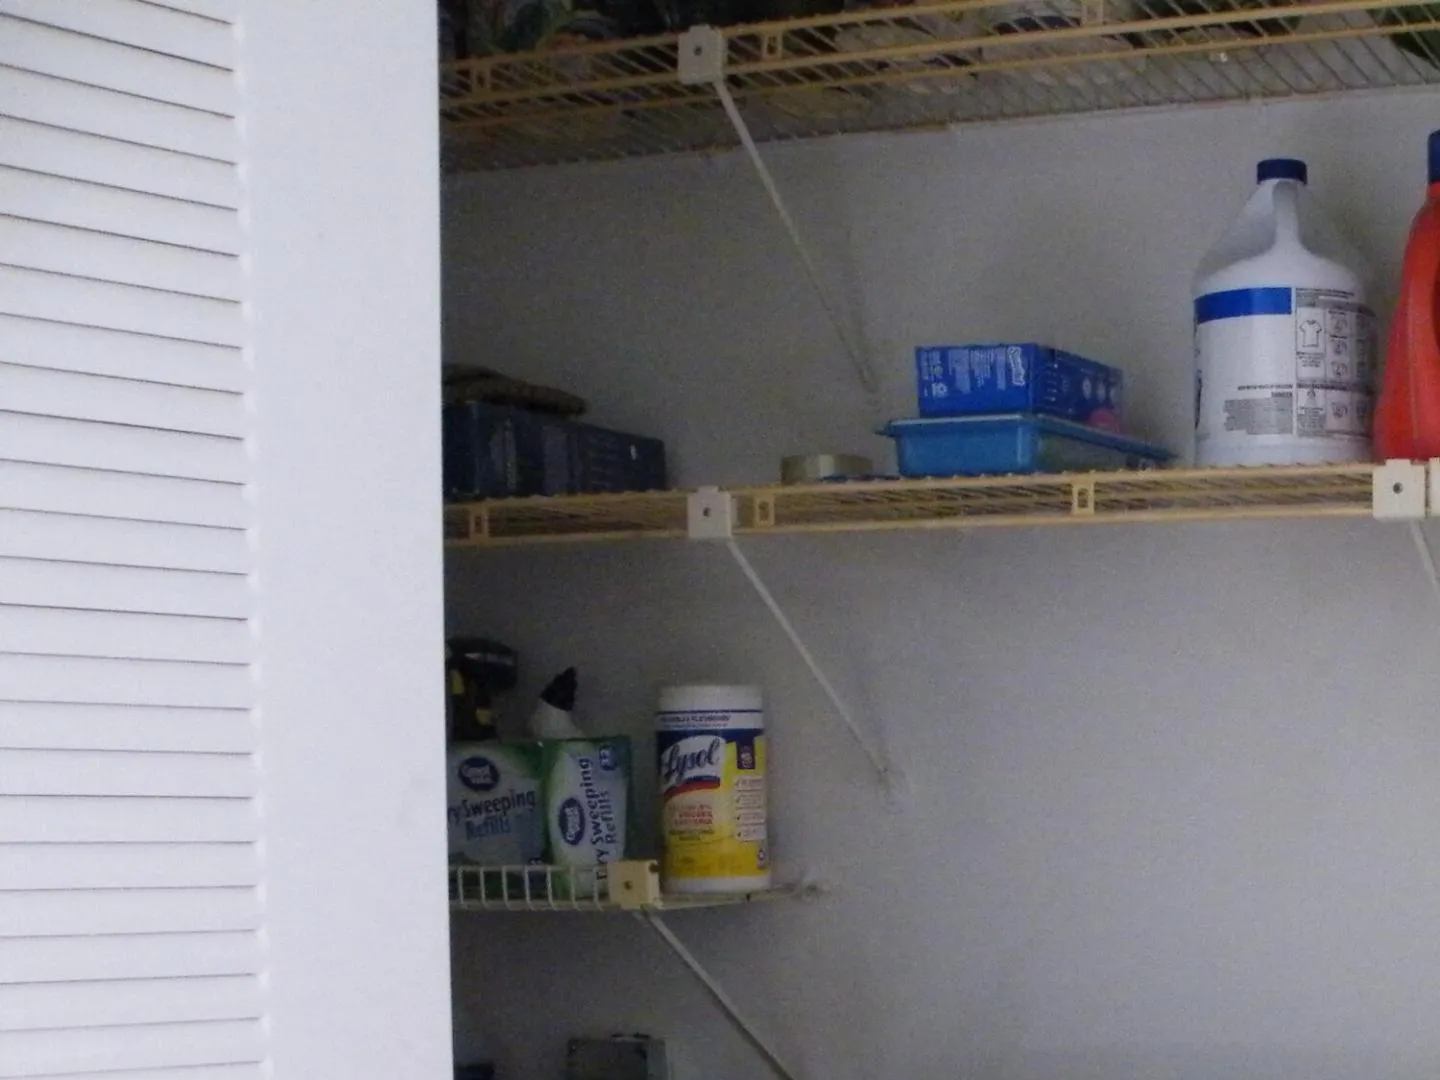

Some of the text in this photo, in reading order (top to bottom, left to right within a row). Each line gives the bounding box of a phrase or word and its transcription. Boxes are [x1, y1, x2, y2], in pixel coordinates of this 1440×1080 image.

[661, 739, 721, 783] Lysol
[462, 790, 537, 819] Sweeping
[578, 757, 605, 846] Sweeping
[596, 790, 617, 845] Refills
[465, 816, 511, 840] Refills
